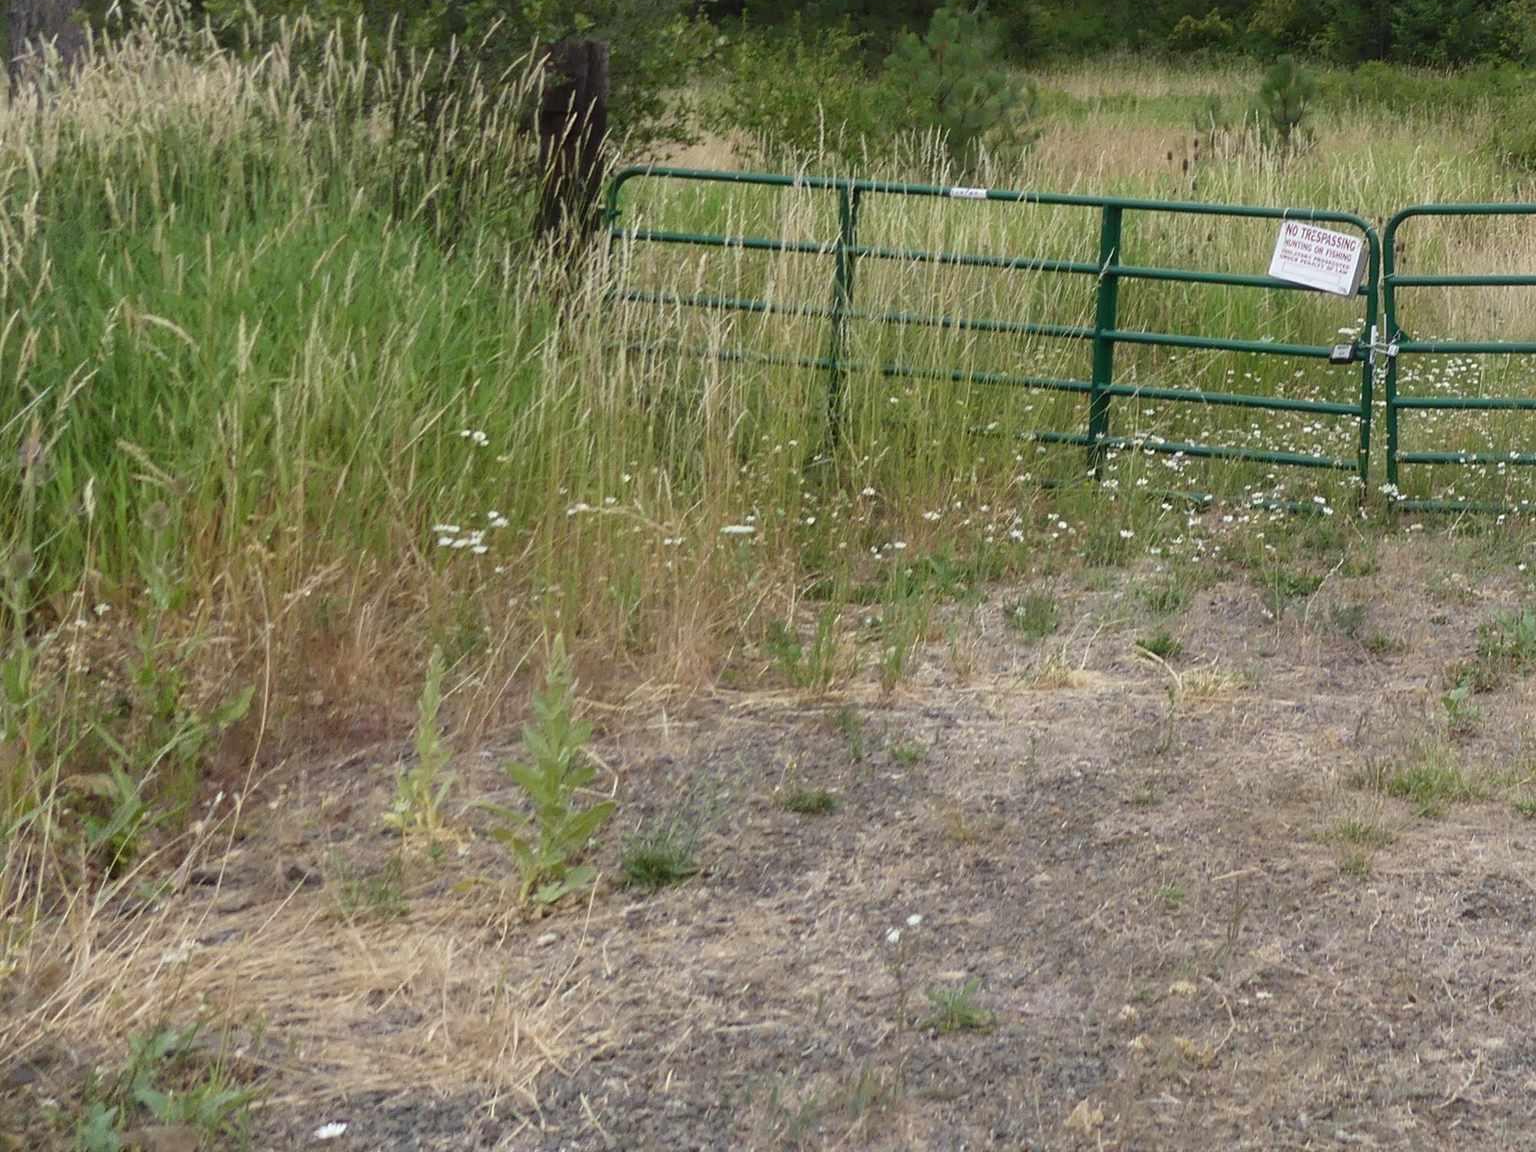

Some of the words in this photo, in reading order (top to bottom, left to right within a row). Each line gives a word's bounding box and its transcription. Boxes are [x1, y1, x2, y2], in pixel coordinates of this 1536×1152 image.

[1285, 223, 1298, 235] NO
[1301, 227, 1356, 252] TRESPASSING
[1285, 239, 1312, 254] HUNTING
[1314, 245, 1323, 255] OR
